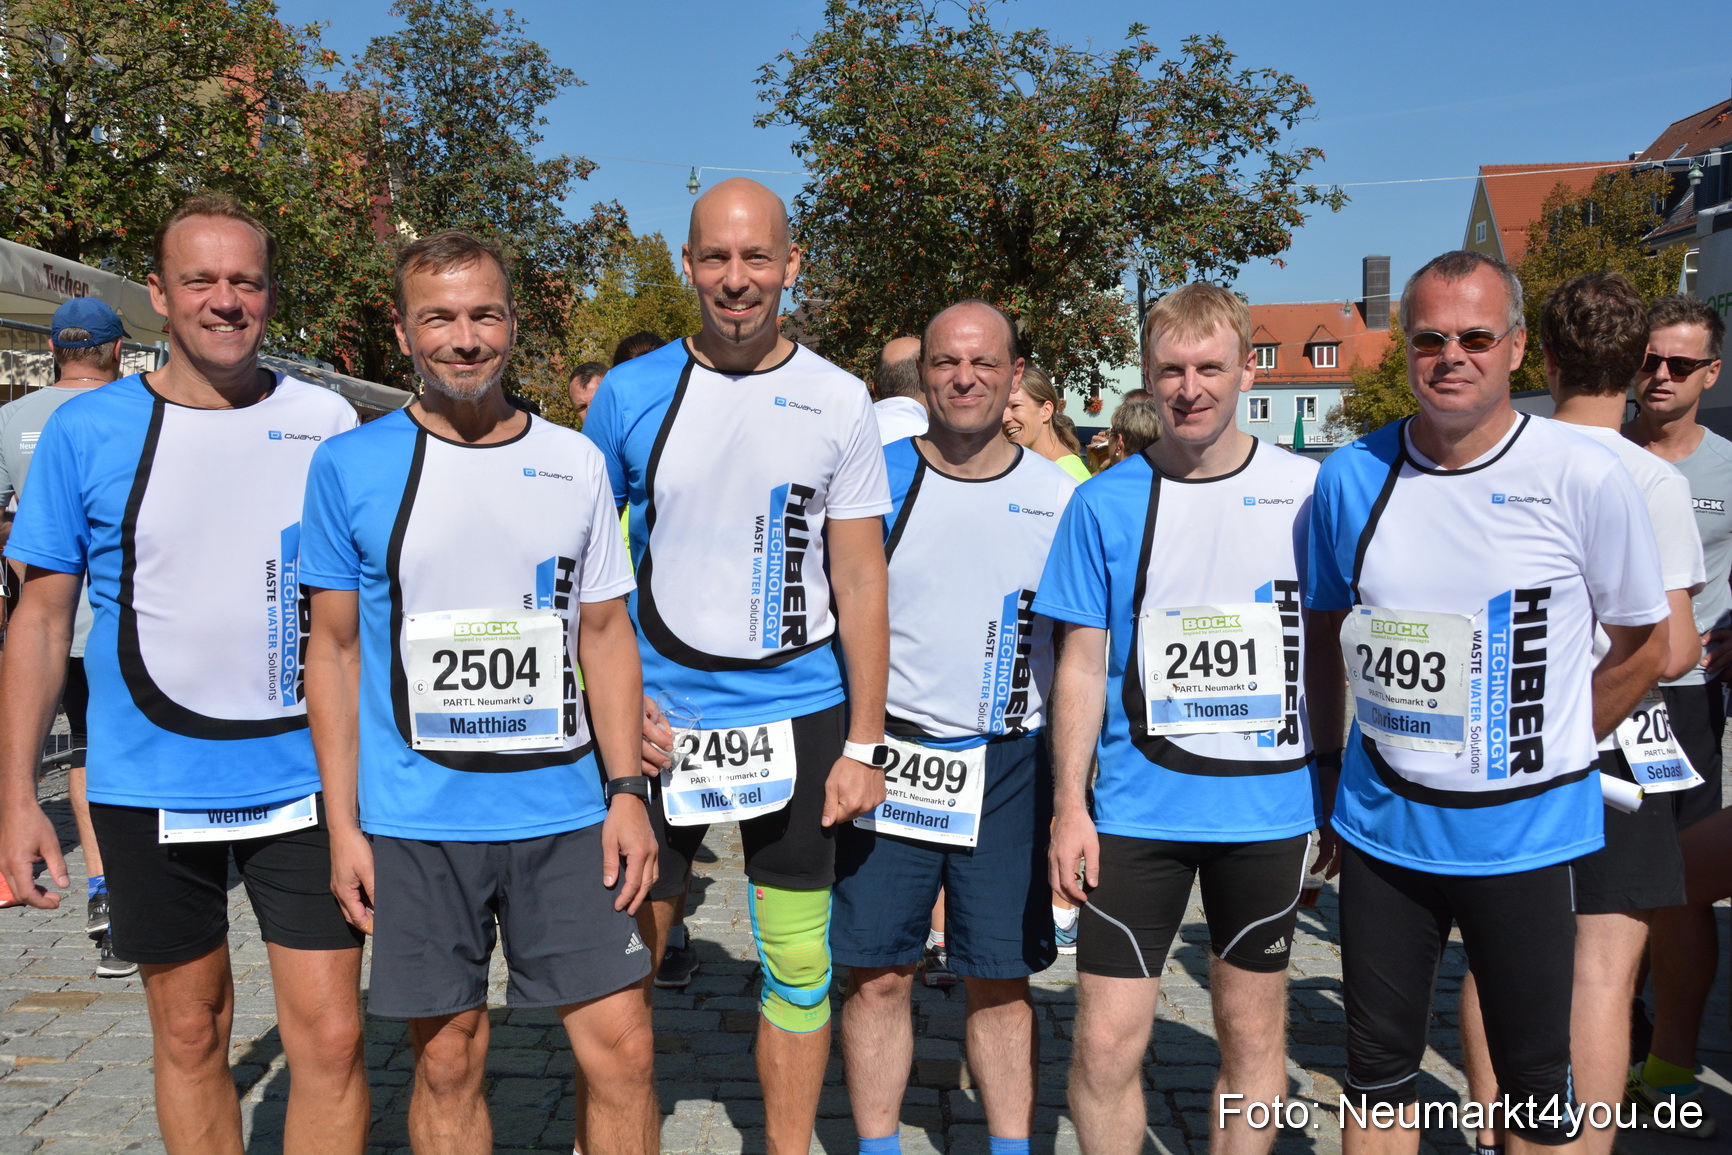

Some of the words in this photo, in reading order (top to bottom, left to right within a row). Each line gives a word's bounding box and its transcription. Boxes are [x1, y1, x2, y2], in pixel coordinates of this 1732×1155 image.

[43, 263, 89, 298] Tucher
[753, 515, 765, 554] WASTE
[265, 559, 276, 602] WASTE
[751, 556, 763, 595] WATER
[765, 515, 783, 642] TECHNOLOGY
[781, 483, 816, 648] HUBER
[267, 605, 278, 649] WATER
[283, 560, 296, 698] TECHNOLOGY
[454, 621, 521, 637] BOCK
[749, 598, 760, 642] Solutions
[984, 620, 998, 658] WASTE
[1182, 615, 1242, 631] BOCK
[1371, 619, 1430, 638] BOCK
[432, 647, 540, 691] 2504
[1165, 638, 1257, 680] 2491
[1356, 643, 1446, 693] 2493
[1470, 630, 1482, 675] WASTE
[268, 652, 278, 701] Solutions
[980, 661, 993, 699] WATER
[1175, 685, 1203, 693] PARTL
[1205, 683, 1245, 692] Neumarkt
[1509, 586, 1552, 777] HUBER
[443, 698, 475, 707] PARTL
[477, 697, 521, 706] Neumarkt
[1183, 702, 1249, 718] Thomas
[1368, 688, 1386, 700] PARTL
[1385, 694, 1424, 707] Neumarkt
[1469, 678, 1482, 723] WATER
[1490, 629, 1508, 772] TECHNOLOGY
[450, 716, 527, 734] Matthias
[1371, 707, 1431, 734] Christian
[679, 726, 774, 772] 2494
[1470, 725, 1482, 775] Solutions
[1644, 748, 1666, 757] PARTL
[884, 747, 968, 794] 2499
[207, 804, 270, 824] Werner
[881, 803, 950, 829] Bernhard
[910, 794, 945, 806] Neumarkt
